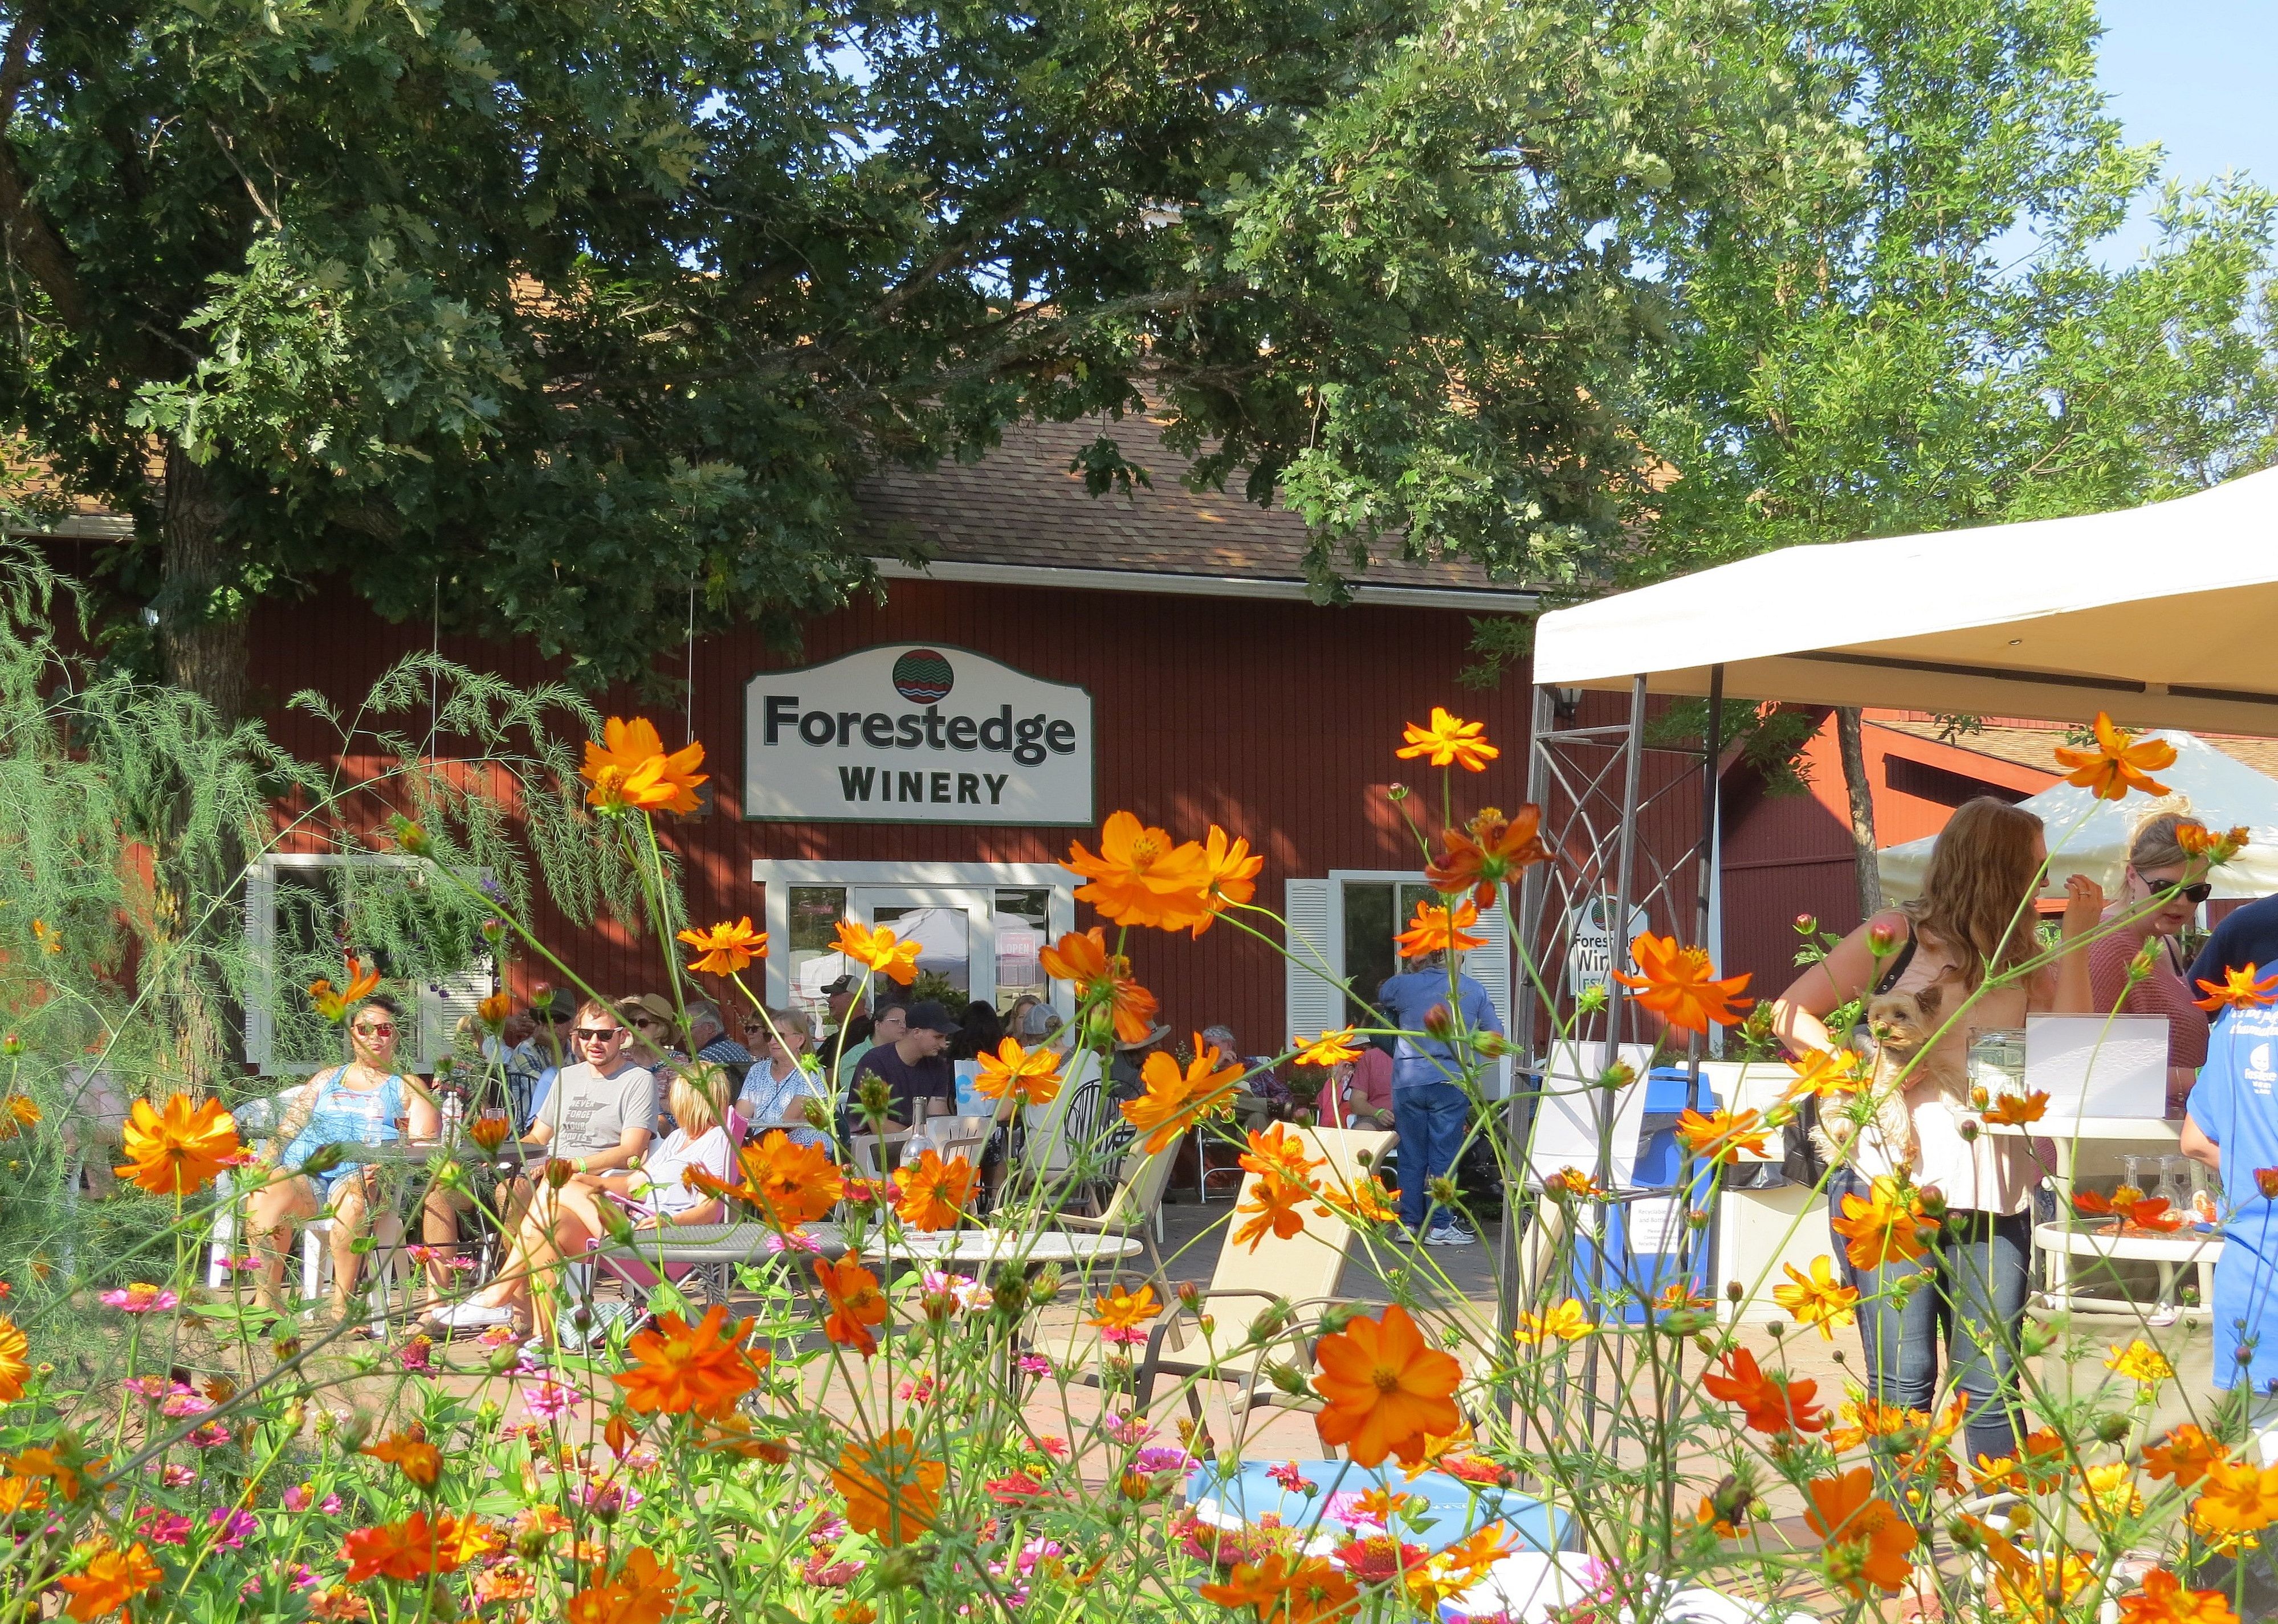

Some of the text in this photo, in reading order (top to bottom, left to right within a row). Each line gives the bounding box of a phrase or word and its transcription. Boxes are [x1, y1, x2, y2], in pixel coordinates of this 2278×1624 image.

[764, 695, 1076, 768] Forestedge
[838, 766, 1009, 805] WINERY
[1006, 944, 1029, 954] OPEN
[1574, 933, 1641, 950] Foresg
[1576, 949, 1641, 976] Winy
